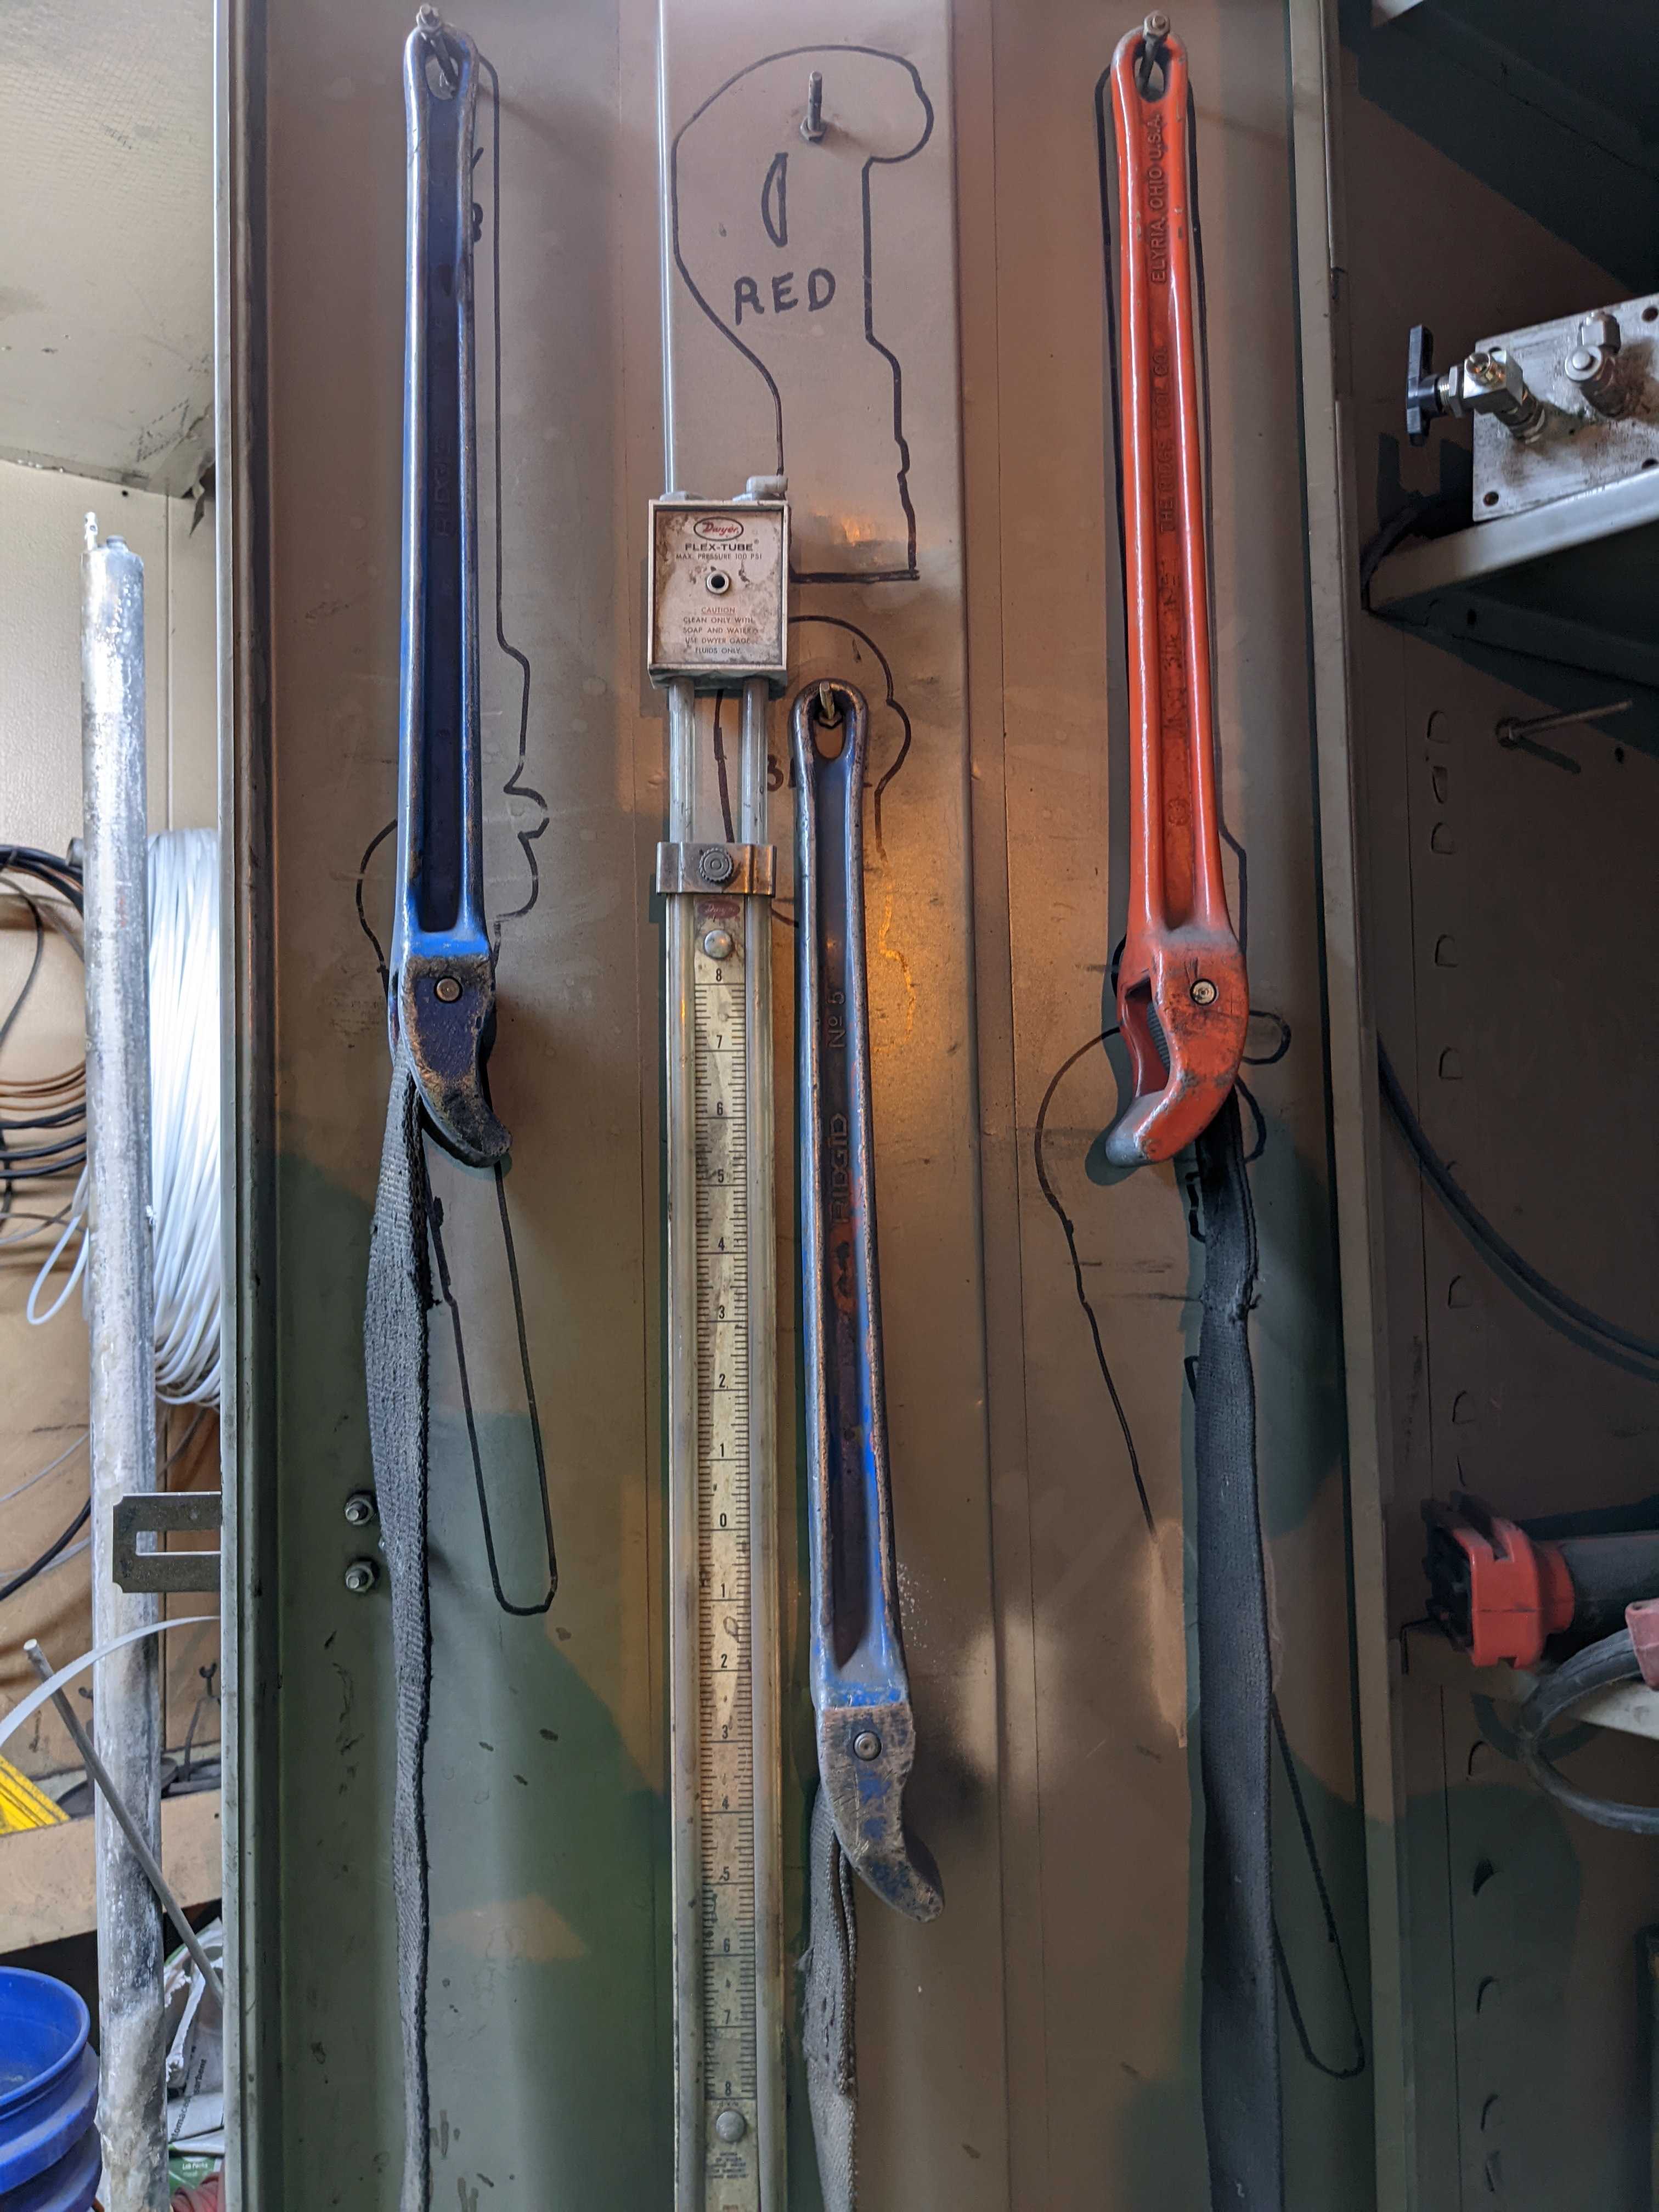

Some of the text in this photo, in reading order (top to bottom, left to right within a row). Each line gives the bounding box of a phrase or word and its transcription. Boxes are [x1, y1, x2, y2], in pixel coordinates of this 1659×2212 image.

[1149, 166, 1164, 211] OHIO
[733, 268, 836, 325] RED
[702, 521, 738, 536] Dwyer
[715, 968, 722, 981] 8
[827, 991, 845, 1006] 5
[716, 1035, 723, 1048] 7
[716, 1102, 723, 1116] 6
[718, 1169, 724, 1183] 5
[718, 1237, 725, 1251] 4
[719, 1306, 725, 1319] 3
[719, 1374, 726, 1388] 2
[719, 1513, 727, 1527] 0
[720, 1654, 727, 1668] 2
[722, 1725, 729, 1739] 3
[721, 1796, 729, 1809] 4
[723, 1866, 730, 1881] 5
[723, 1938, 730, 1953] 6
[724, 2010, 731, 2024] 7
[725, 2080, 732, 2096] 8
